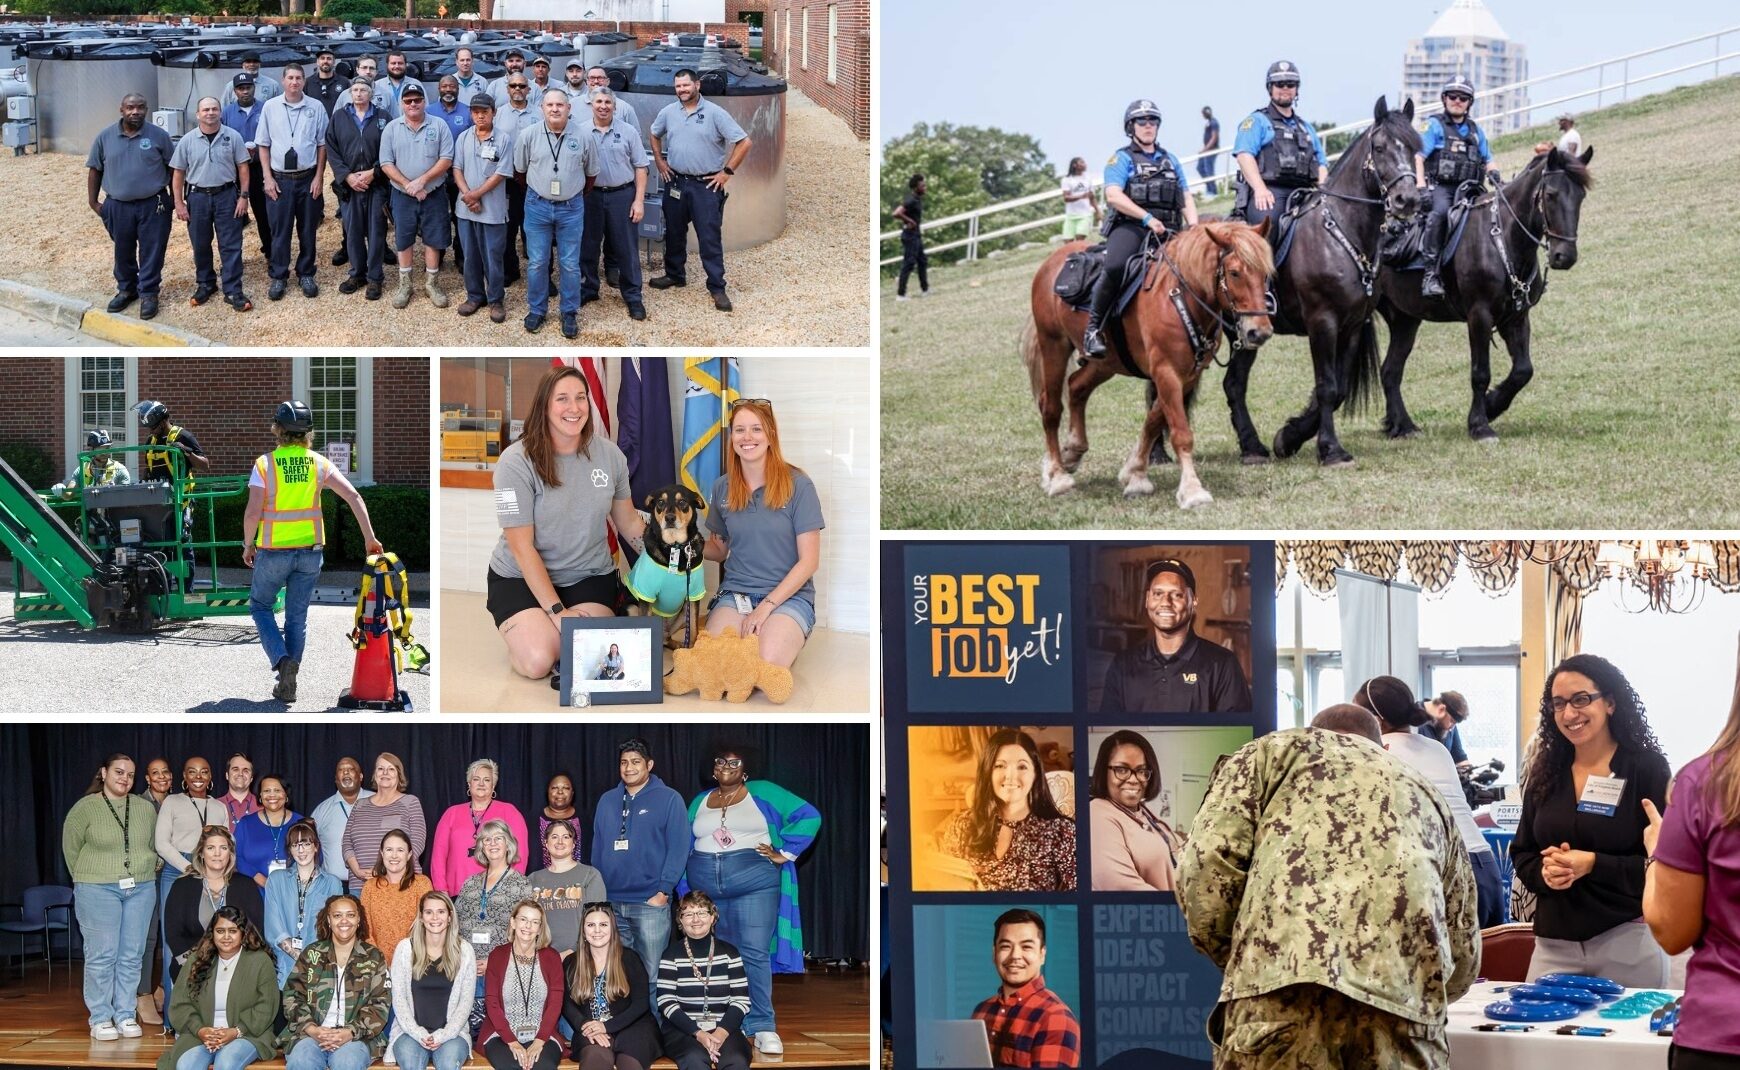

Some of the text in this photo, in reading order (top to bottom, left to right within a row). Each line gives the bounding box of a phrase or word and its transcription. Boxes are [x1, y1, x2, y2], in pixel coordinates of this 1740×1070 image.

[275, 456, 314, 466] VA BEACH
[283, 465, 310, 475] SAFETY
[284, 474, 309, 483] OFFICE
[913, 574, 929, 625] YOUR
[930, 573, 1040, 625] BEST
[931, 612, 1063, 684] job yet!
[1182, 673, 1198, 682] VB
[1094, 938, 1166, 967] IDEAS
[1095, 972, 1190, 1001] IMPACT
[1096, 1006, 1210, 1035] COMPAS
